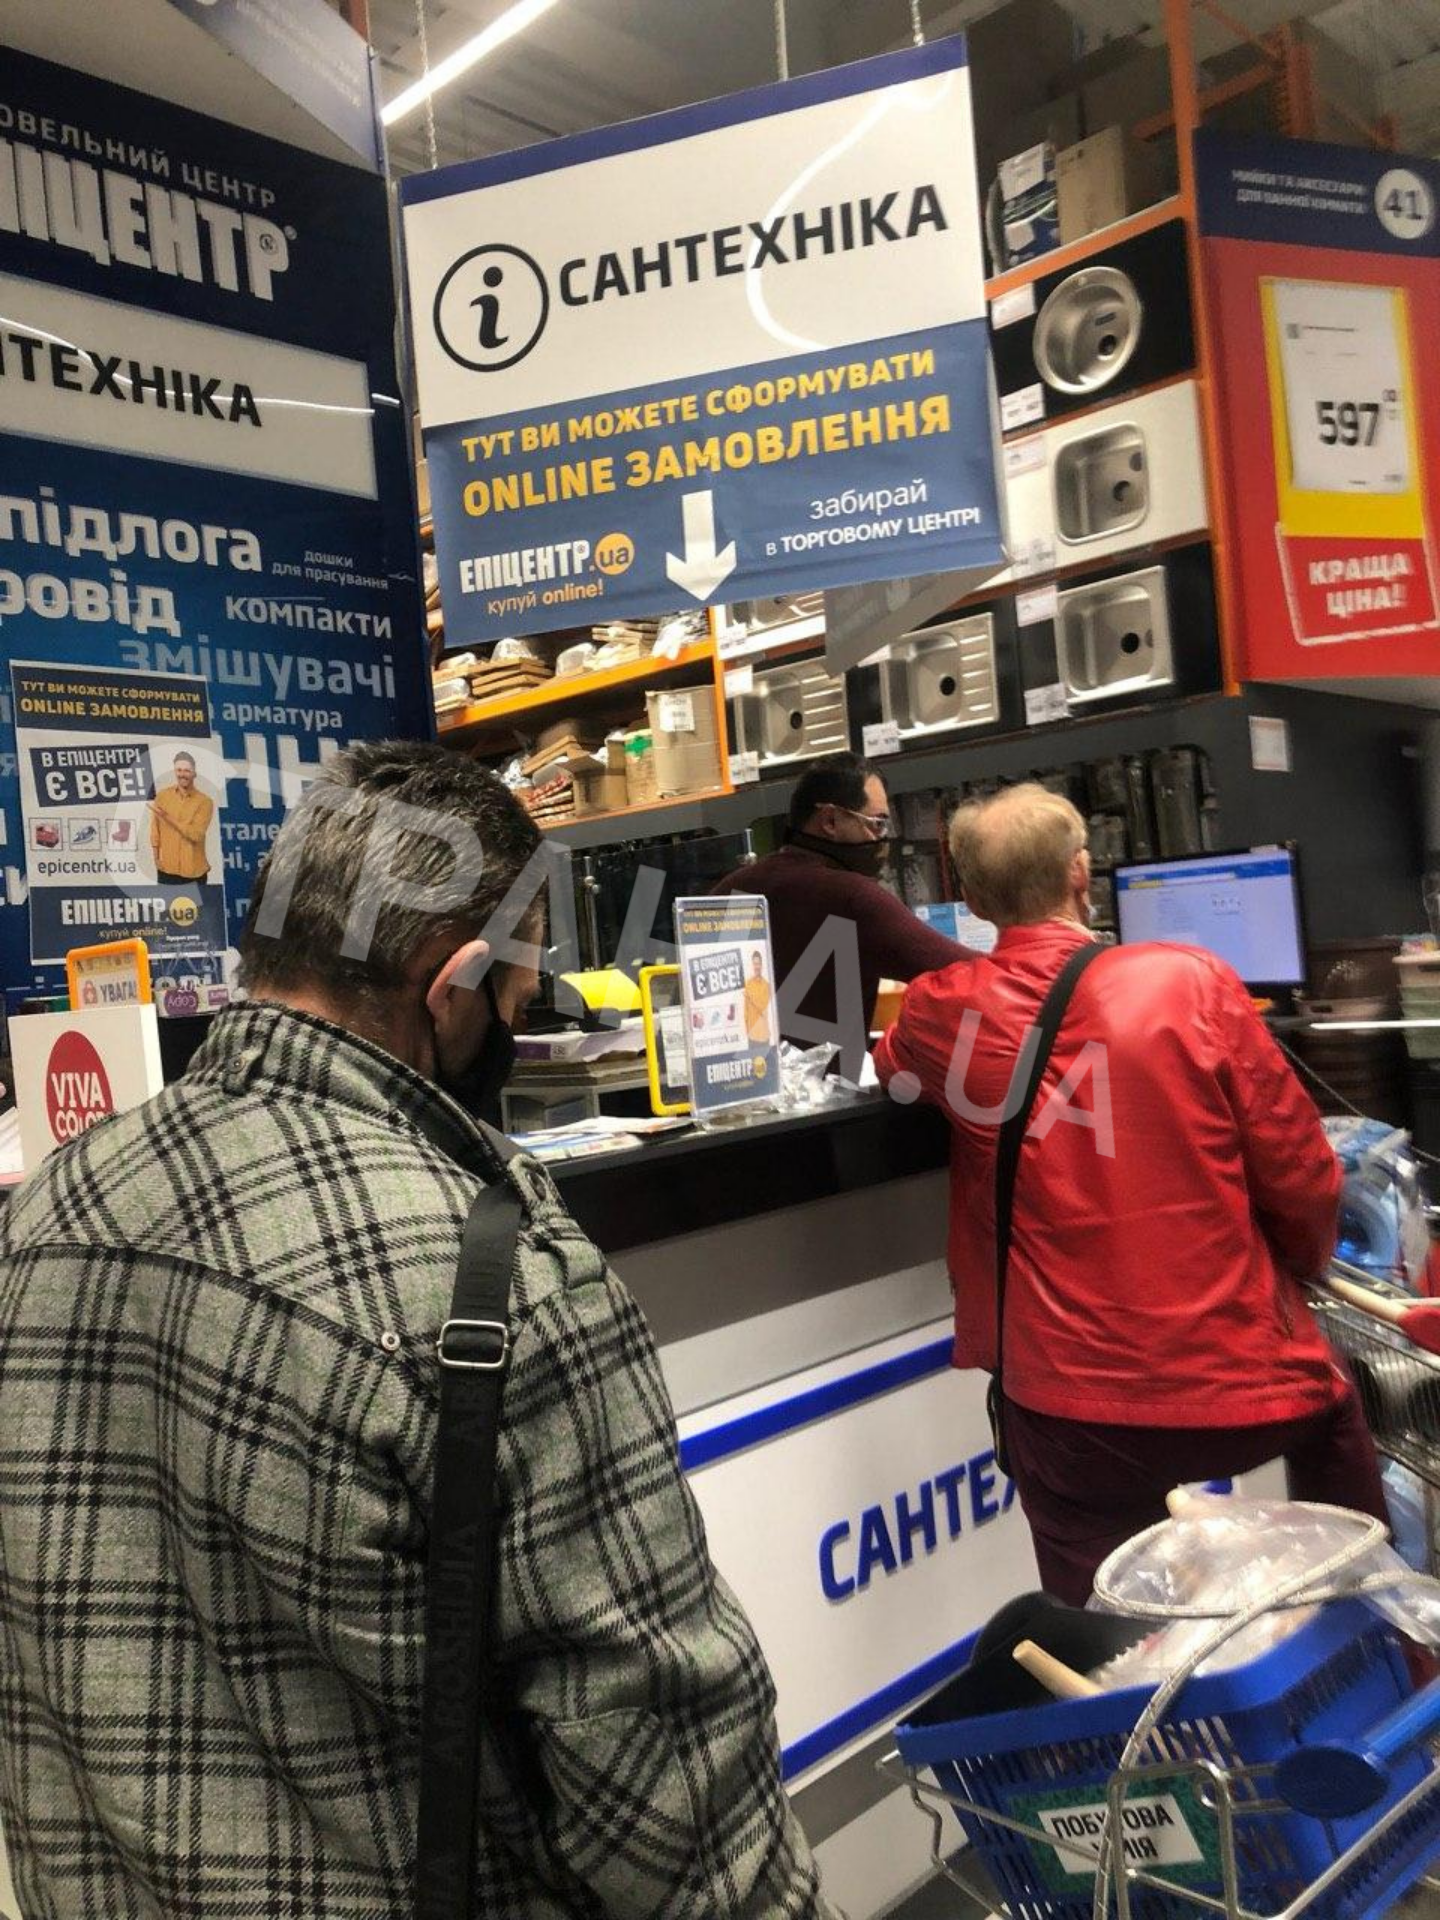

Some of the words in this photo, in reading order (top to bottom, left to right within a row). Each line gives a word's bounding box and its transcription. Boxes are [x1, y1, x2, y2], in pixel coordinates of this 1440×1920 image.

[182, 162, 276, 208] ЦЕНТР
[1383, 188, 1423, 221] 41
[559, 184, 949, 307] САНТЕХНІКА
[461, 430, 515, 463] ТУТ
[521, 422, 561, 452] ВИ
[568, 395, 699, 443] МОЖЕТЕ
[706, 349, 935, 415] СФОРМУВАТИ
[1315, 401, 1380, 447] 597
[463, 456, 616, 517] ONLINE
[625, 394, 950, 487] ЗАМОВЛЕННЯ
[809, 478, 928, 520] забирай
[780, 519, 903, 553] ТОРГОВОМУ
[907, 507, 981, 536] ЦЕНТРІ
[272, 562, 301, 577] для
[305, 567, 389, 590] прасування
[304, 550, 354, 568] дошки
[1309, 553, 1414, 586] КРАЩА
[487, 588, 537, 617] купуй
[543, 577, 604, 604] online!
[1326, 583, 1407, 618] ЦІНА!
[226, 595, 393, 639] компакти
[119, 634, 396, 700] змішувачі
[21, 680, 45, 692] ТУТ
[48, 682, 65, 693] ВИ
[67, 683, 119, 697] МОЖЕТЕ
[122, 687, 201, 703] СФОРМУВАТИ
[21, 698, 86, 716] ONLINE
[90, 702, 204, 723] ЗАМОВЛЕННЯ
[222, 702, 343, 732] арматура
[42, 752, 54, 767] В
[57, 748, 142, 768] ЕПІЦЕНТРІ
[45, 771, 68, 801] Є
[75, 767, 147, 800] ВСЕ!
[38, 858, 136, 876] epicentrk.ua
[708, 964, 741, 993] ВСЕ!
[51, 1072, 106, 1108] VIVA
